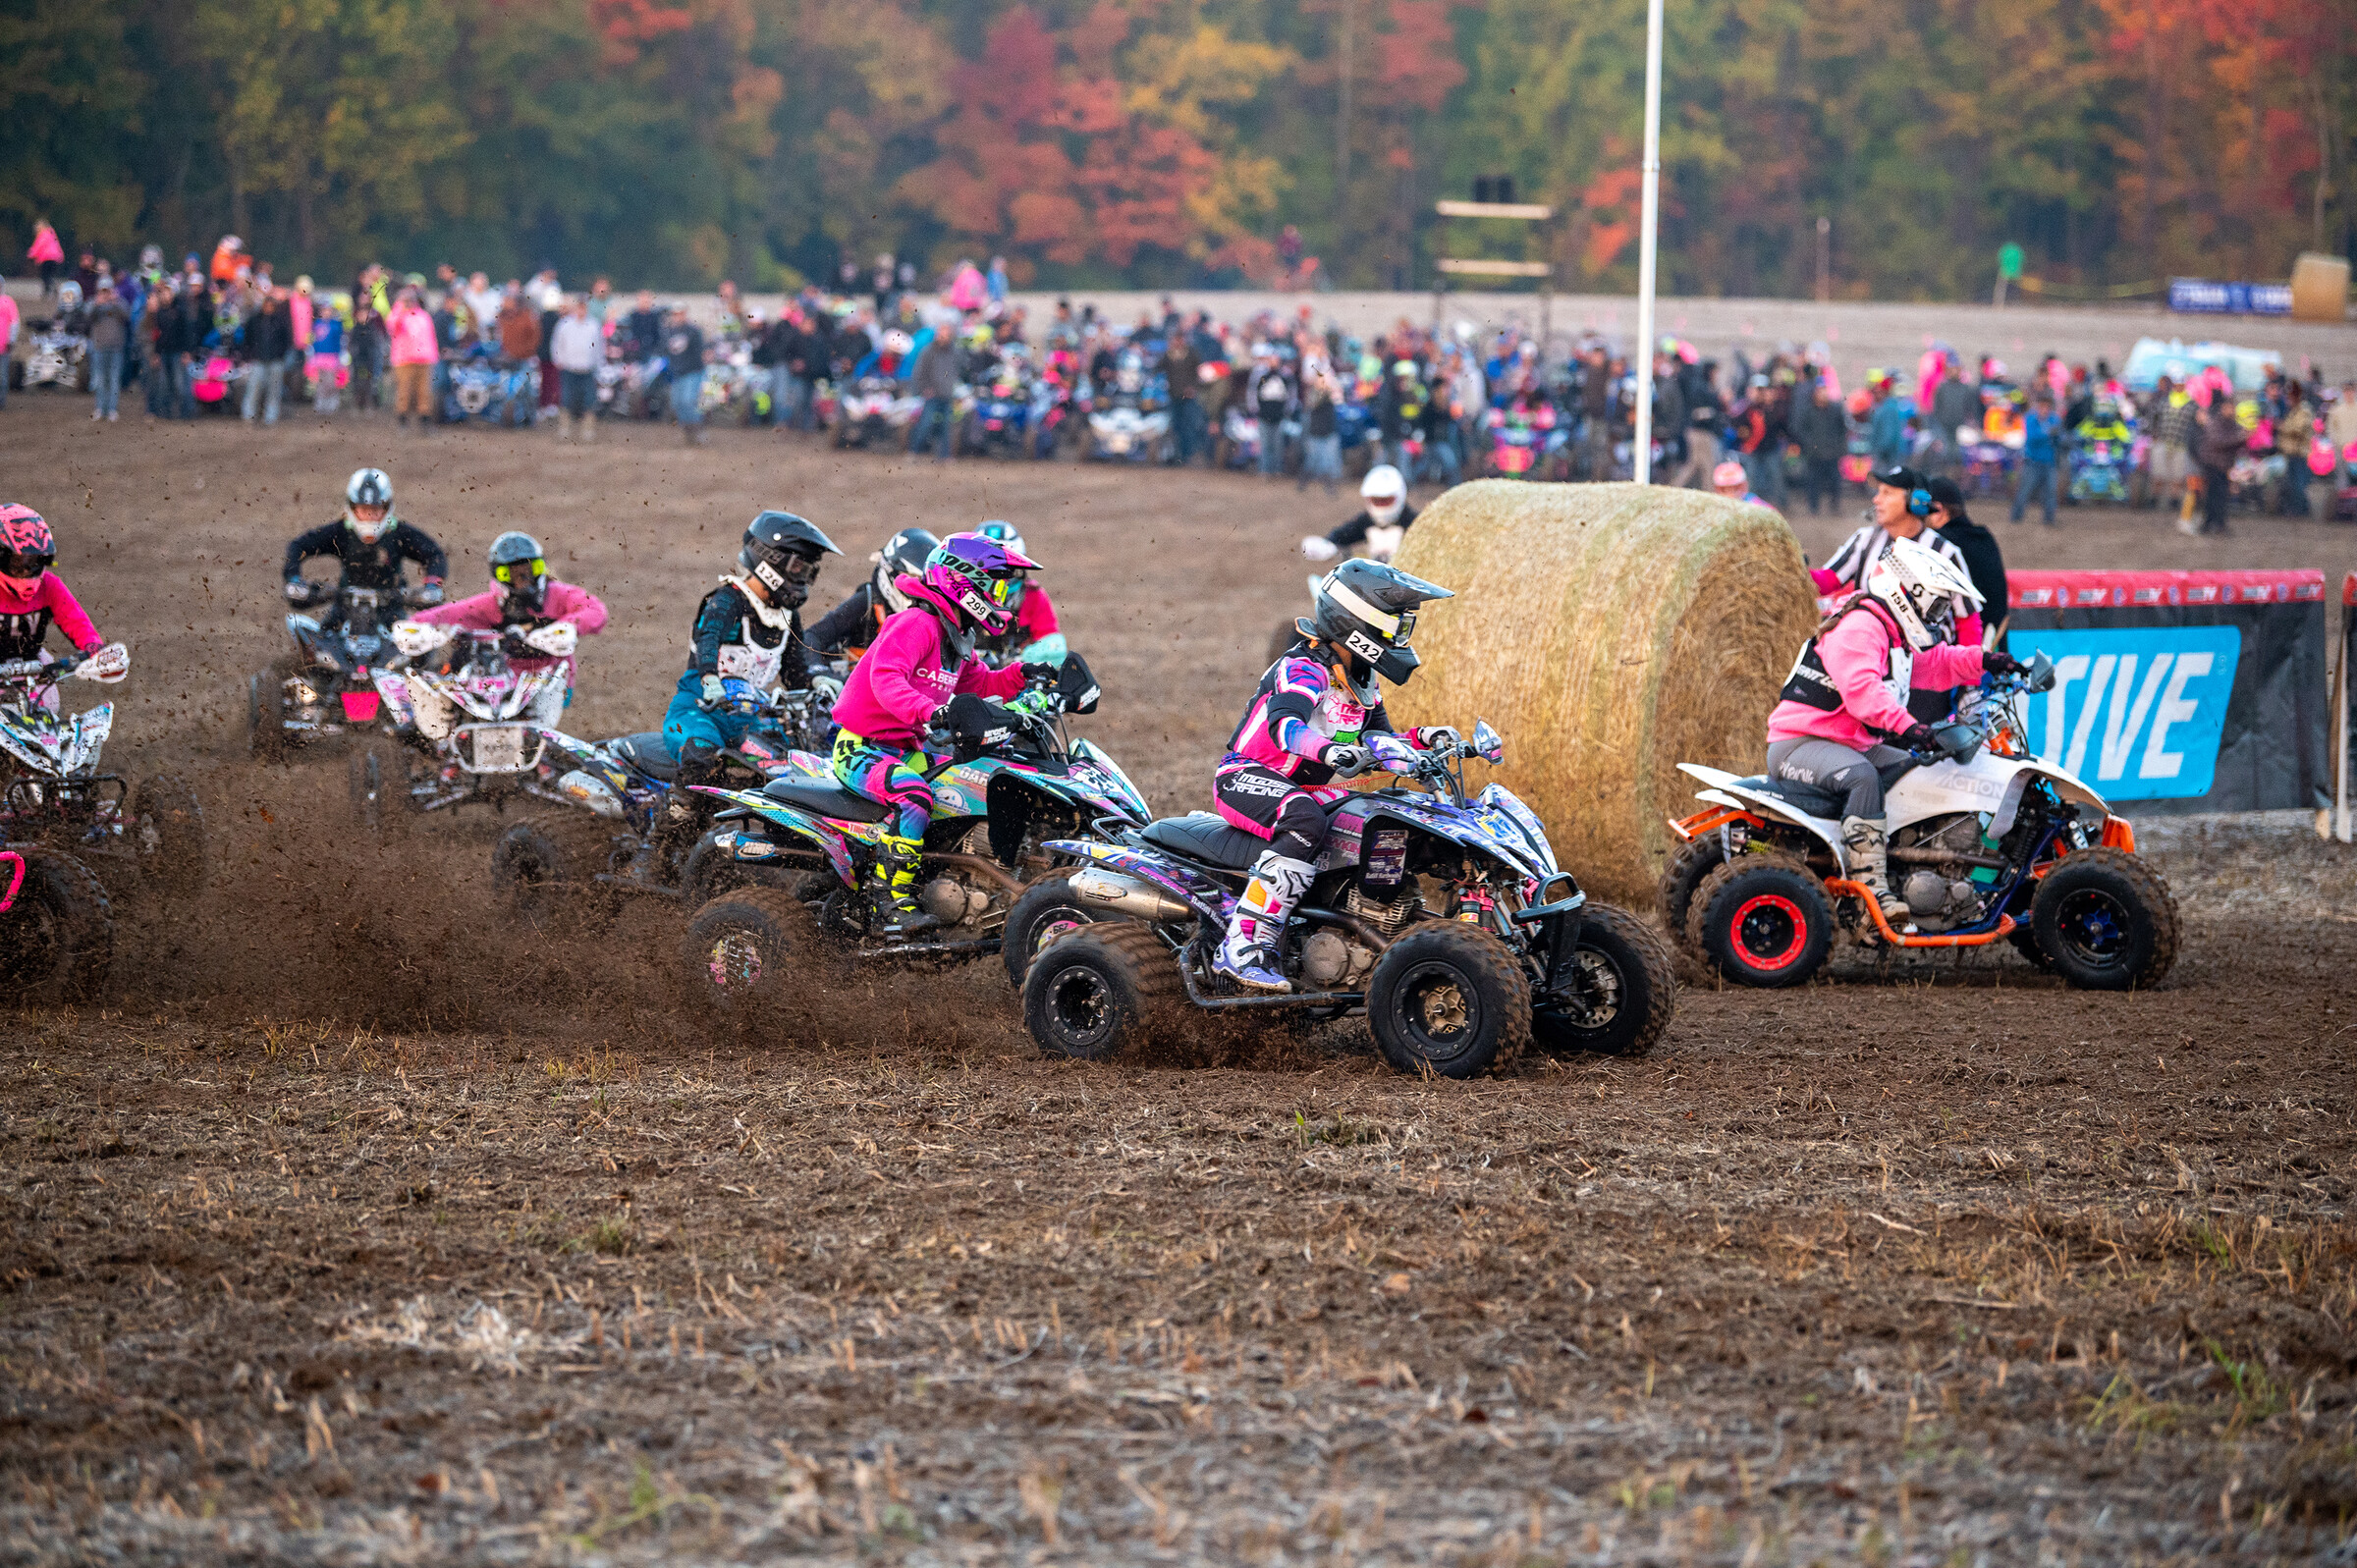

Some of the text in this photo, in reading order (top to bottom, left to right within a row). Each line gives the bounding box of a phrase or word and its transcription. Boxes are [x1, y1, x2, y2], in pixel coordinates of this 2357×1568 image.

[965, 596, 987, 616] 299
[1348, 634, 1380, 661] 242
[1233, 783, 1289, 798] RACING
